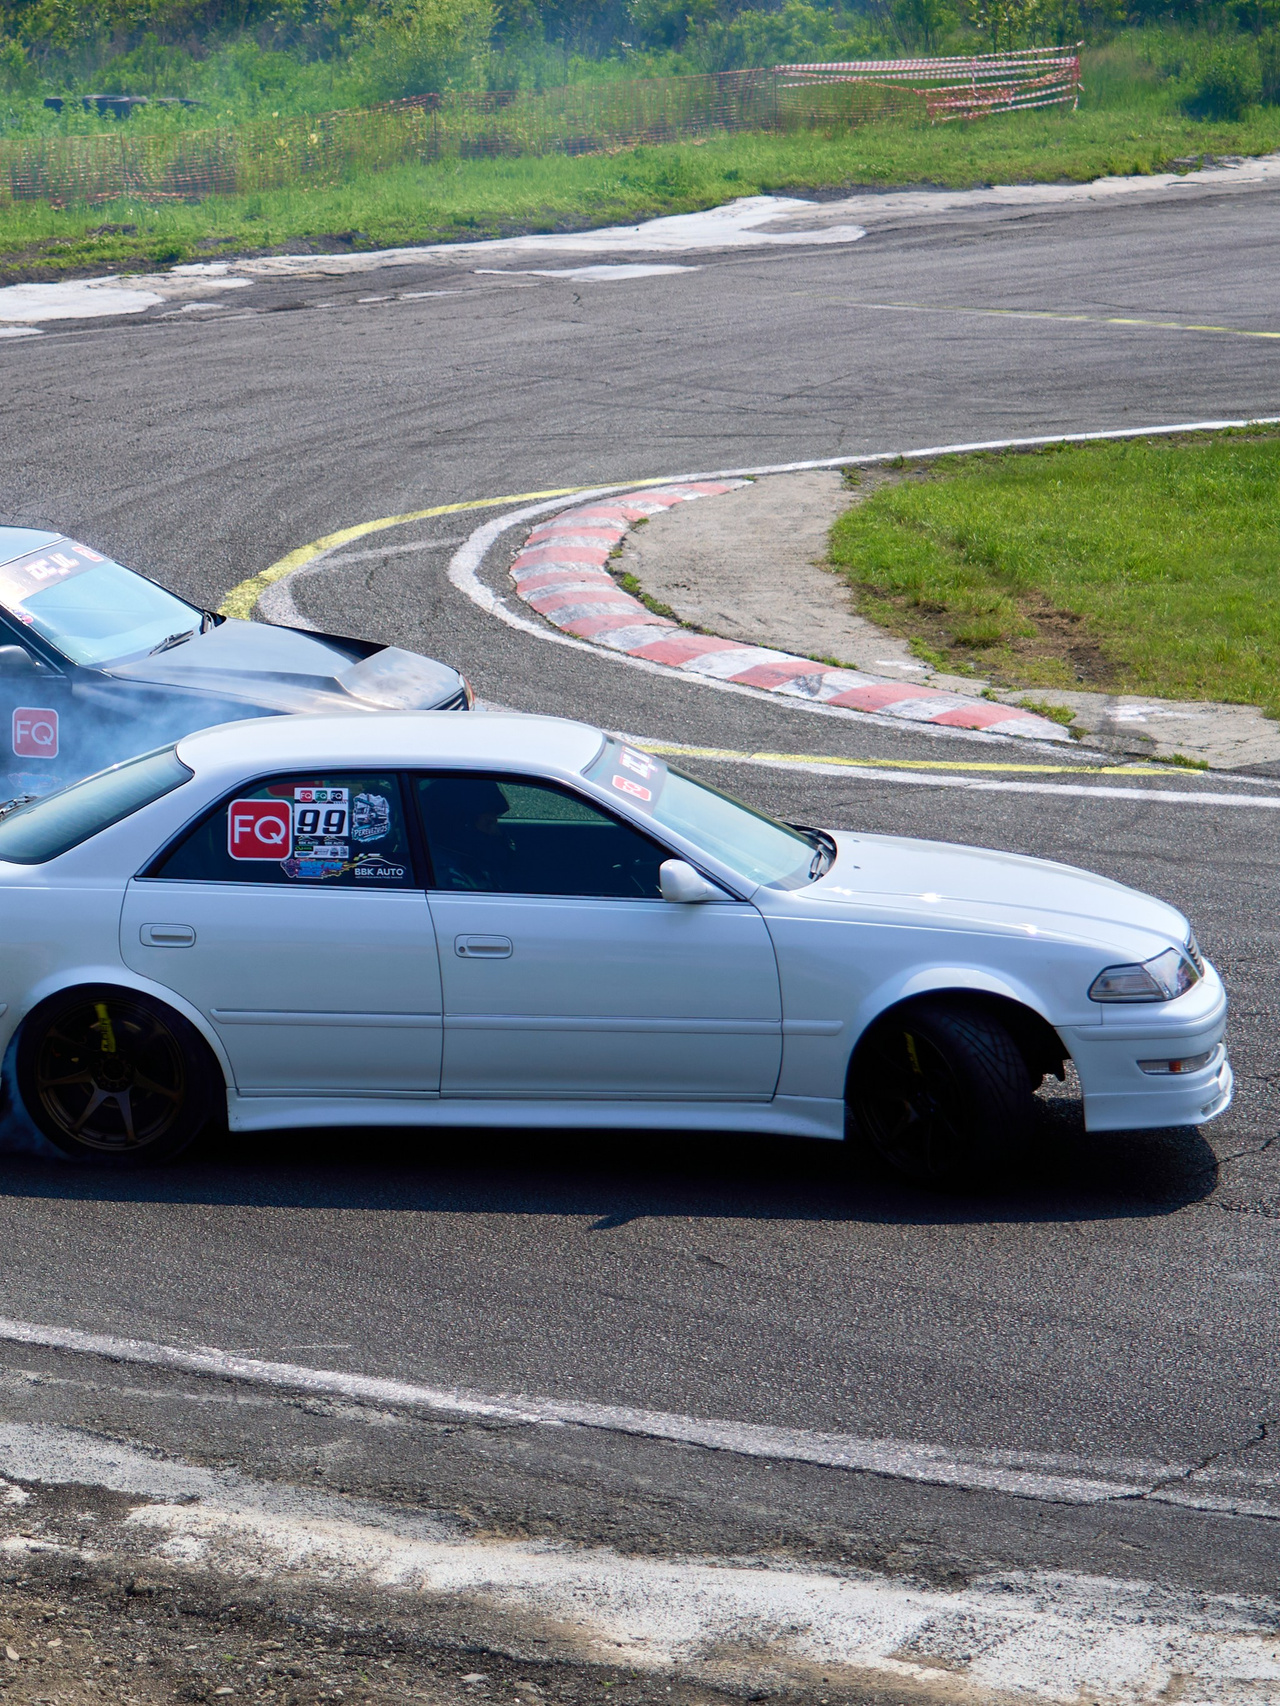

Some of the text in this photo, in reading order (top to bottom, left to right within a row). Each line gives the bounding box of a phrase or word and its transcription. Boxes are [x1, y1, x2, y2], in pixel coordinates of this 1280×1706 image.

[16, 720, 54, 746] FQ
[233, 815, 287, 845] FQ
[297, 809, 346, 834] 99
[354, 868, 404, 876] BBK AUTO
